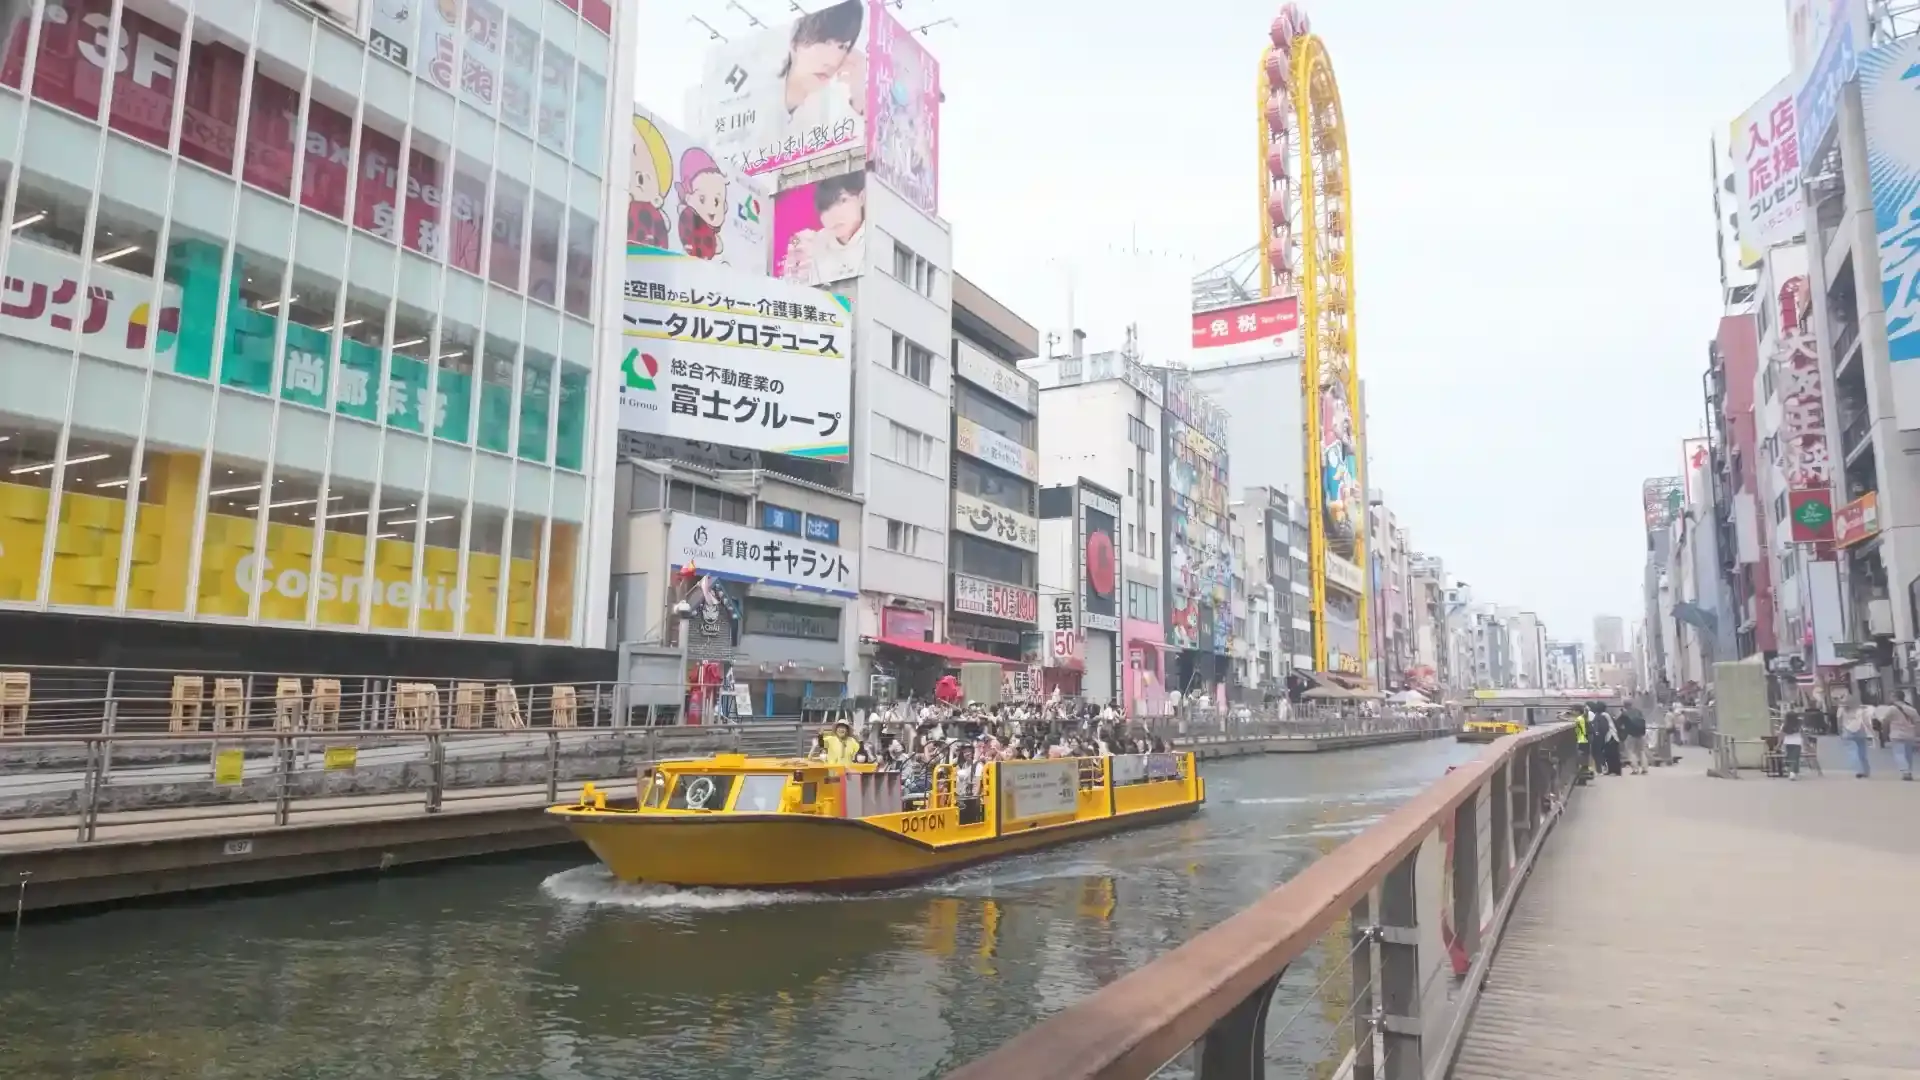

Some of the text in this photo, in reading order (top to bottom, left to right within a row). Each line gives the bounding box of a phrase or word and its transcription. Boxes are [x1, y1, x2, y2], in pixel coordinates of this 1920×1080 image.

[78, 13, 180, 89] 3F
[371, 34, 403, 62] 4F
[1745, 94, 1796, 162] 入店
[282, 108, 351, 169] Tax
[364, 153, 445, 208] Free
[1749, 174, 1806, 222] プレゼン
[1210, 313, 1257, 338] 免税
[670, 358, 785, 395] 総合不動産業の
[628, 397, 658, 412] Group
[671, 383, 842, 437] 富士グループ
[721, 537, 850, 582] 賃貸のギャラント
[235, 553, 473, 613] Cosmetic
[993, 586, 1009, 616] 50
[1015, 590, 1037, 620] 190
[1054, 597, 1074, 630] 伝串
[1055, 631, 1075, 656] 50
[902, 812, 946, 834] DOTON
